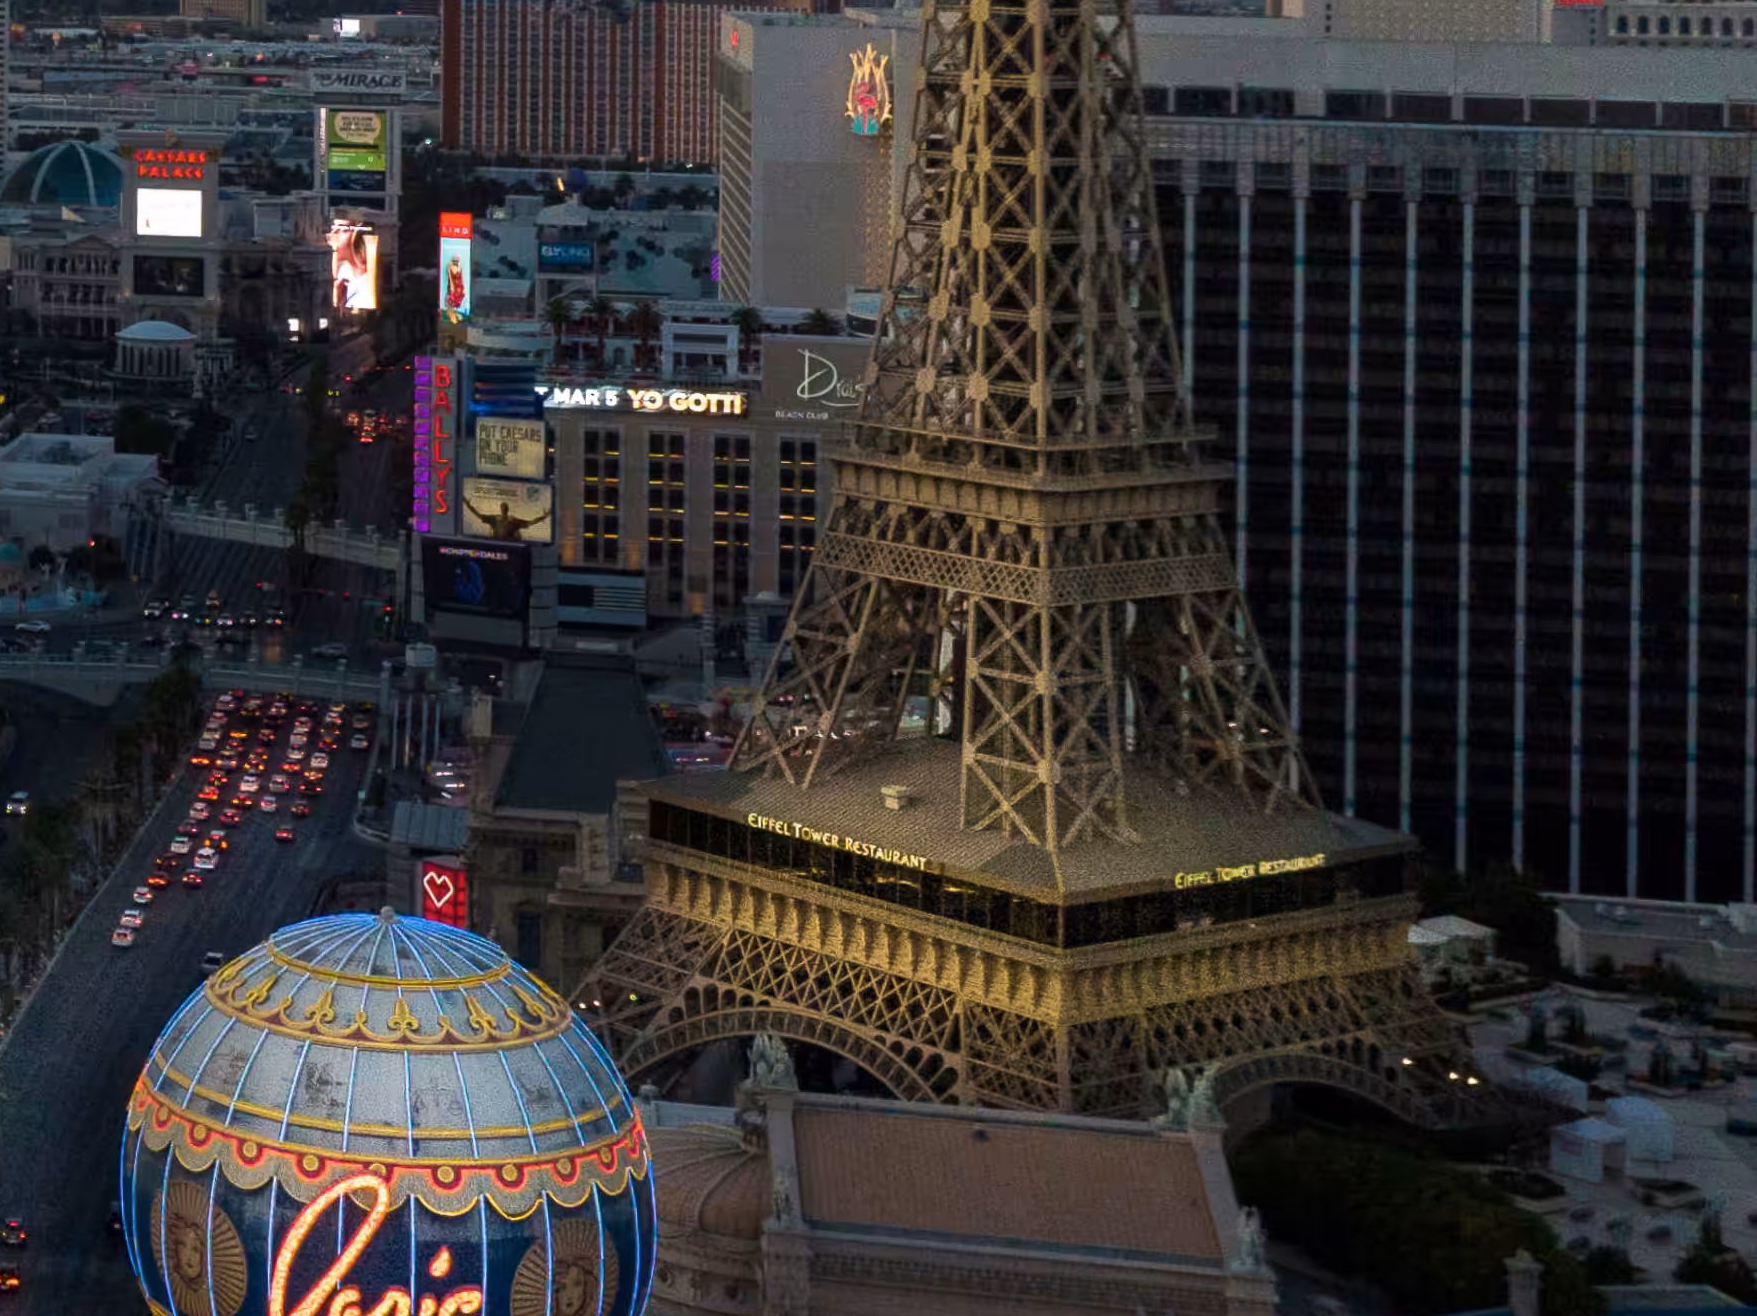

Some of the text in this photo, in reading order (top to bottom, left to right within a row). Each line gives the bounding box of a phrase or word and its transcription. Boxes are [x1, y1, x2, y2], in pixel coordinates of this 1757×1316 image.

[321, 74, 402, 88] MIRAGE
[135, 150, 207, 163] CAESARS
[138, 165, 203, 179] PALACE
[554, 388, 600, 406] MAR
[628, 389, 663, 410] YO
[669, 392, 743, 414] GOTTI
[500, 426, 541, 442] CAESARS
[748, 812, 927, 871] EIFFEL TOWER RESTAURANT
